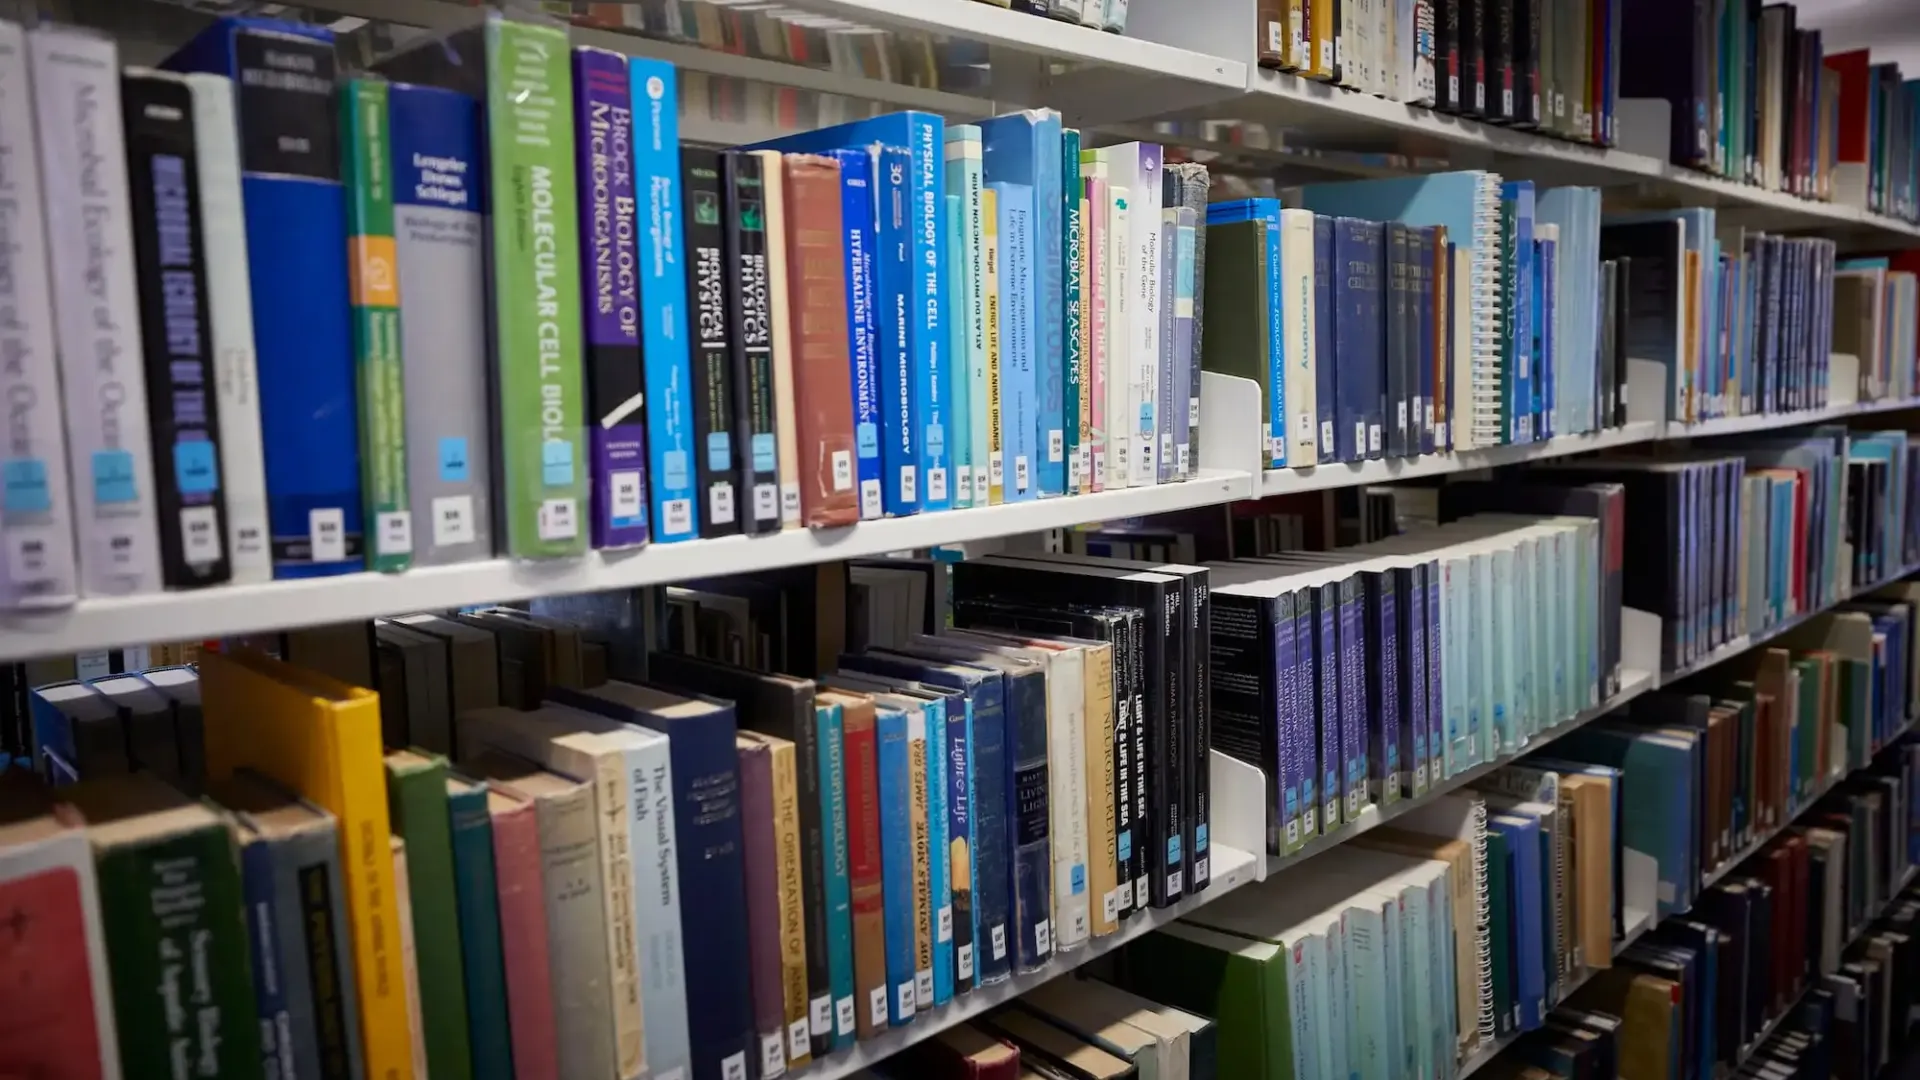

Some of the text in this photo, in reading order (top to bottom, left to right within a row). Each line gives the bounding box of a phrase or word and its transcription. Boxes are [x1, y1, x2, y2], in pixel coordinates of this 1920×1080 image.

[889, 162, 902, 185] 30
[151, 155, 193, 267] MICROBIAL
[589, 101, 615, 315] MICROORGANISMS
[611, 106, 637, 338] BROCK BIOLOGY OF
[922, 123, 938, 330] PHYSICAL BIOLOGY OF THE CELL
[1009, 208, 1017, 227] Life
[530, 165, 558, 317] MOLECULAR
[972, 209, 982, 297] PHYTOPLANCTON
[1141, 244, 1148, 255] of
[696, 246, 713, 339] PHYSICS
[708, 247, 724, 337] BIOLOGICAL
[740, 253, 758, 344] PHYSICS
[754, 254, 770, 343] BIOLOGICAL
[850, 228, 866, 324] HYPERSALINE
[1017, 209, 1029, 372] Enigmatic Microorganisms and
[1069, 208, 1080, 385] MICROBIAL SEASCAPES
[1147, 232, 1157, 313] Molecular Biology
[1507, 214, 1519, 340] ANIMALS
[163, 271, 200, 356] ECOLOGY
[866, 311, 875, 330] and
[990, 331, 998, 348] LIFE
[1010, 292, 1019, 368] Environments
[1273, 307, 1282, 369] ZOOLOGICAL
[1299, 274, 1310, 370] taxonomy
[170, 360, 205, 386] OF
[538, 322, 562, 378] CELL
[896, 293, 911, 454] MARINE MICROBIOLOGY
[173, 390, 209, 426] THE
[991, 372, 999, 406] ANIMAL
[1275, 371, 1284, 424] LITERATURE
[1169, 671, 1177, 708] ANIMAL
[1282, 668, 1290, 713] MARINE
[1289, 664, 1299, 731] HANDBOOK
[1306, 657, 1314, 722] HANDBOOK
[950, 737, 966, 775] Light
[1119, 732, 1128, 741] &
[1119, 743, 1128, 765] LIFE
[1134, 694, 1146, 819] LIGHT & LIFE IN THE SEA
[1284, 717, 1292, 755] FAUNA
[632, 767, 648, 822] of Fish
[652, 763, 667, 795] The
[828, 728, 847, 877] PHOTOPHYSIOLOGY
[914, 777, 924, 810] JAMES
[1103, 711, 1115, 868] NEUROSECRETION
[1120, 767, 1128, 780] IN
[1120, 781, 1129, 803] THE
[654, 798, 671, 846] Visual
[781, 796, 795, 825] THE
[953, 795, 968, 823] Life
[1120, 804, 1129, 827] SEA
[656, 847, 674, 906] System
[783, 832, 800, 933] ORIENTATION
[915, 822, 928, 936] ANIMALS MOVE
[789, 938, 802, 956] OF
